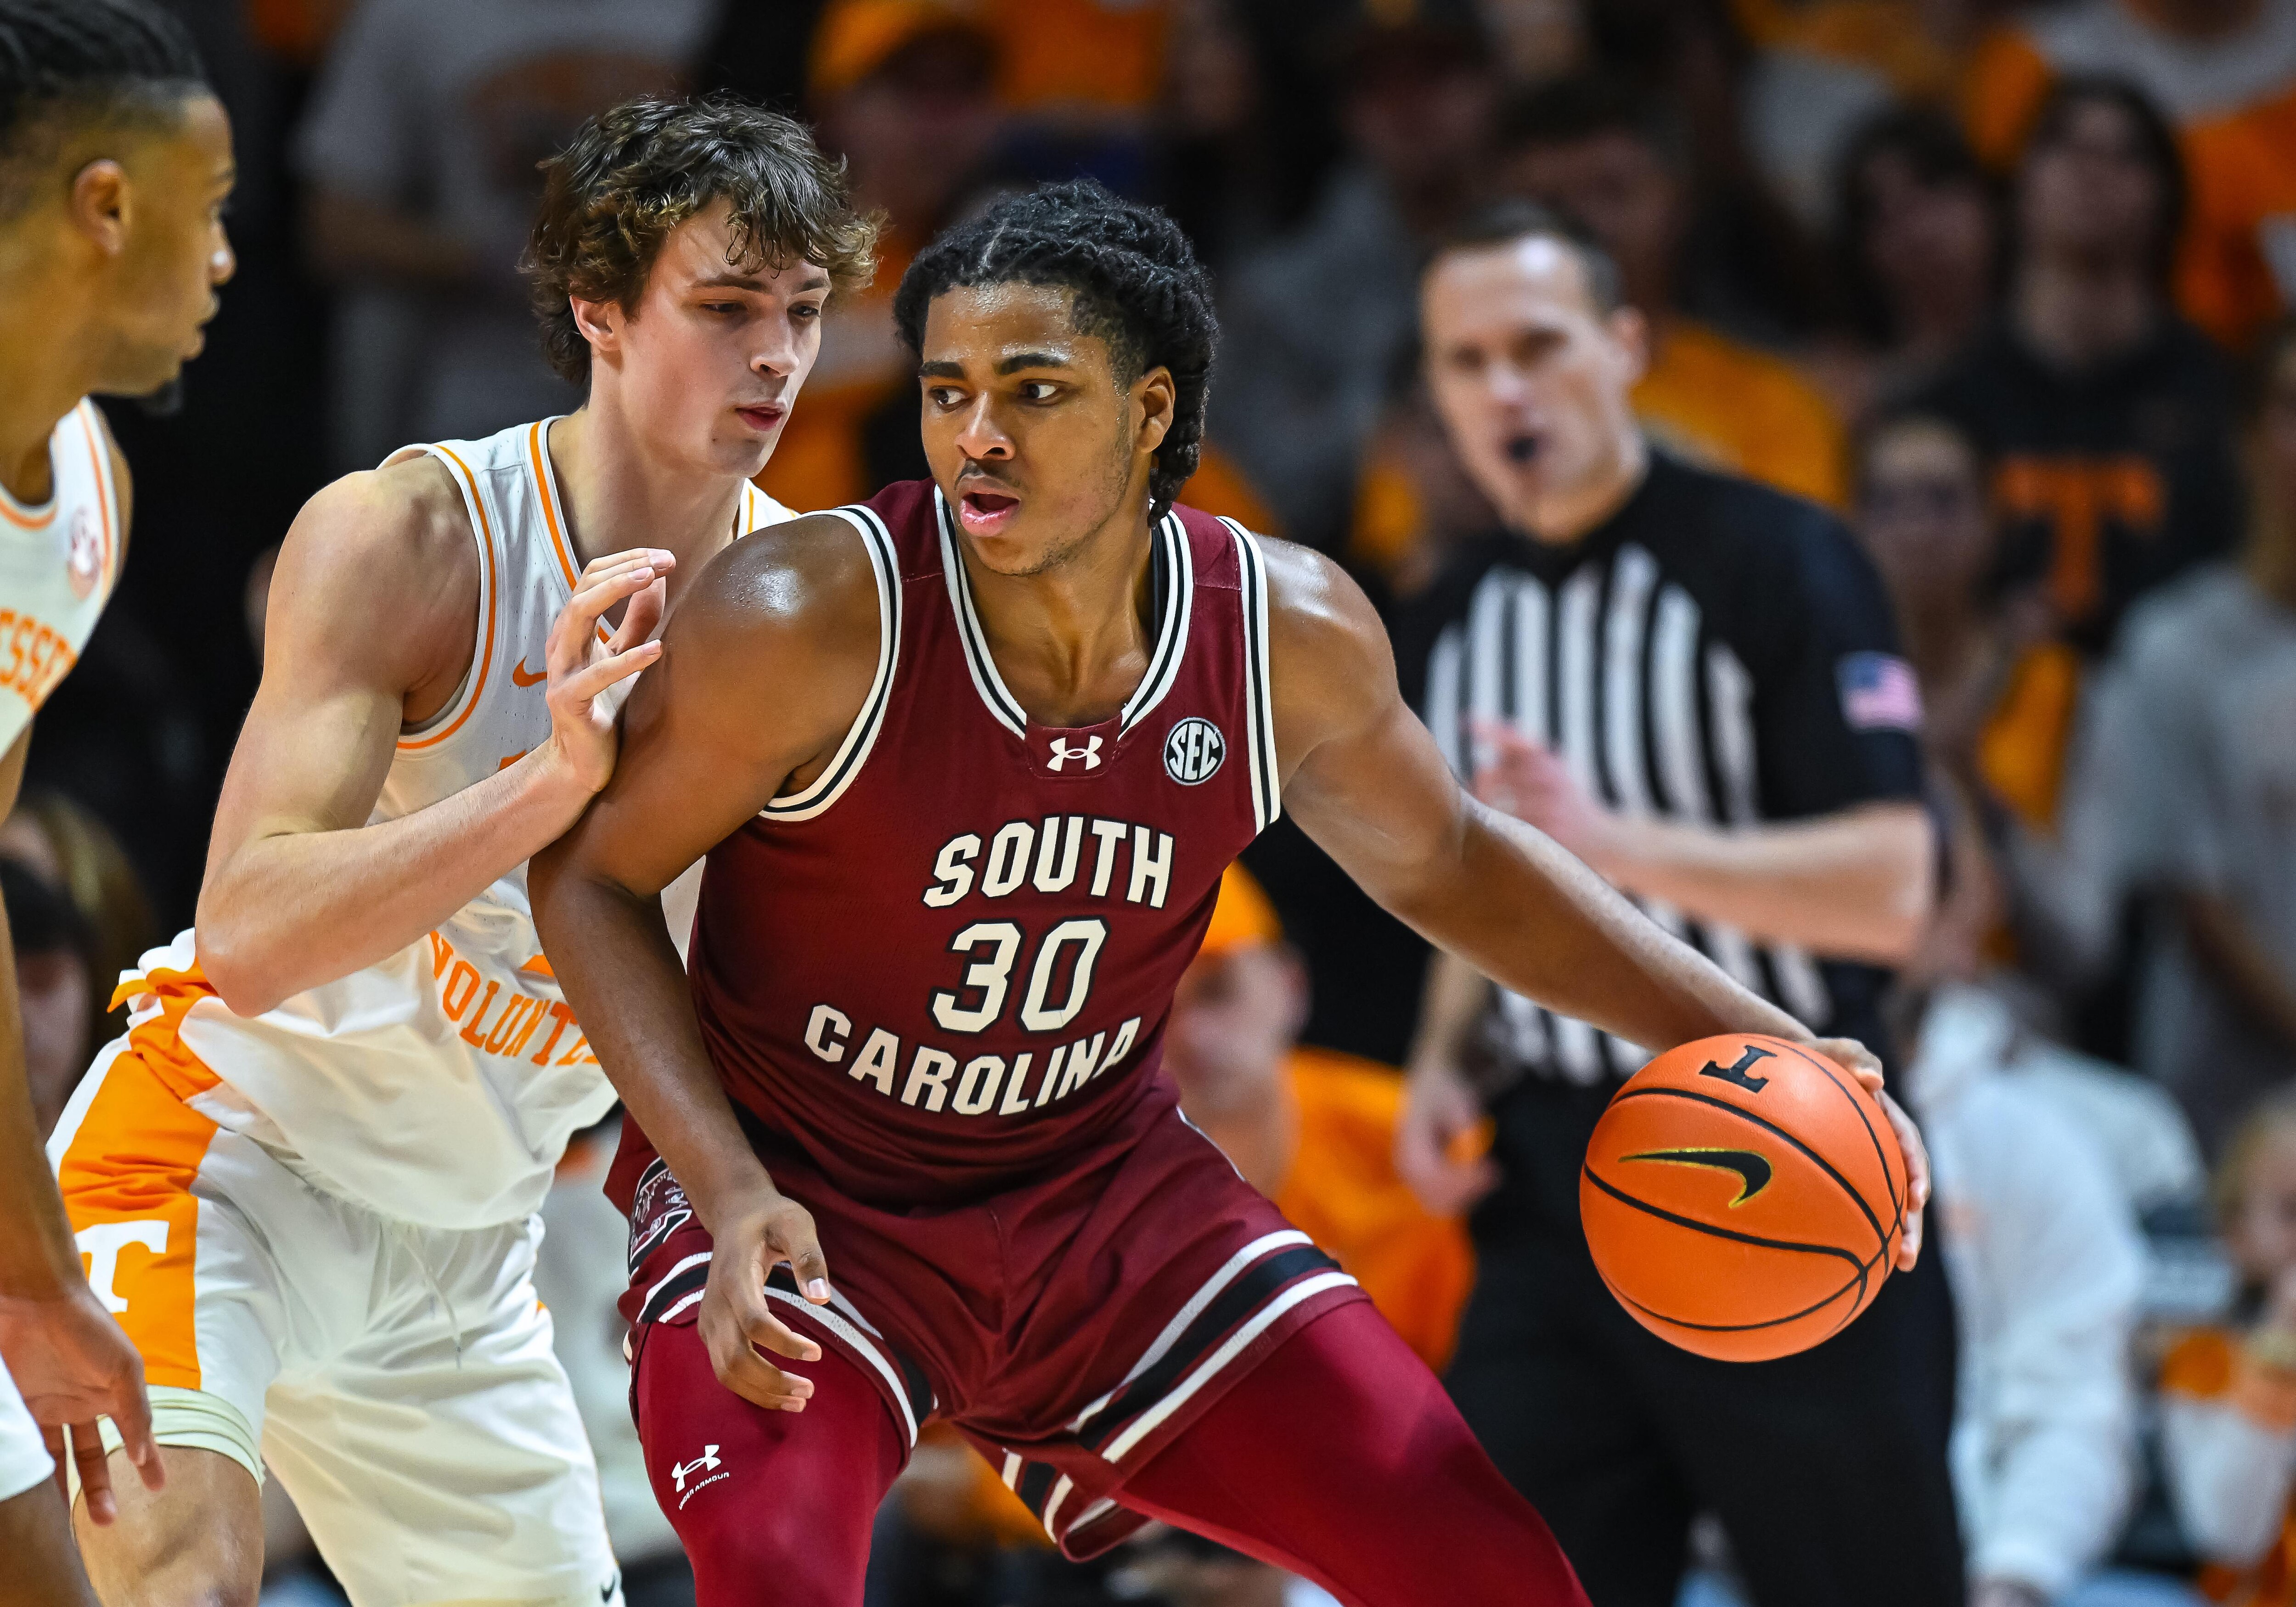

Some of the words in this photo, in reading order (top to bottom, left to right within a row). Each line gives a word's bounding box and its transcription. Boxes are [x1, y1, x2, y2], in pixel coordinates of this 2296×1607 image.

[1169, 722, 1220, 780] SEC
[923, 816, 1174, 909] SOUTH
[931, 919, 1108, 1033] 30
[804, 1004, 1141, 1116] CAROLINA
[1699, 1045, 1778, 1094] T
[74, 1219, 169, 1313] T
[679, 1488, 694, 1511] UNDER
[695, 1472, 730, 1492] ARMOUR
